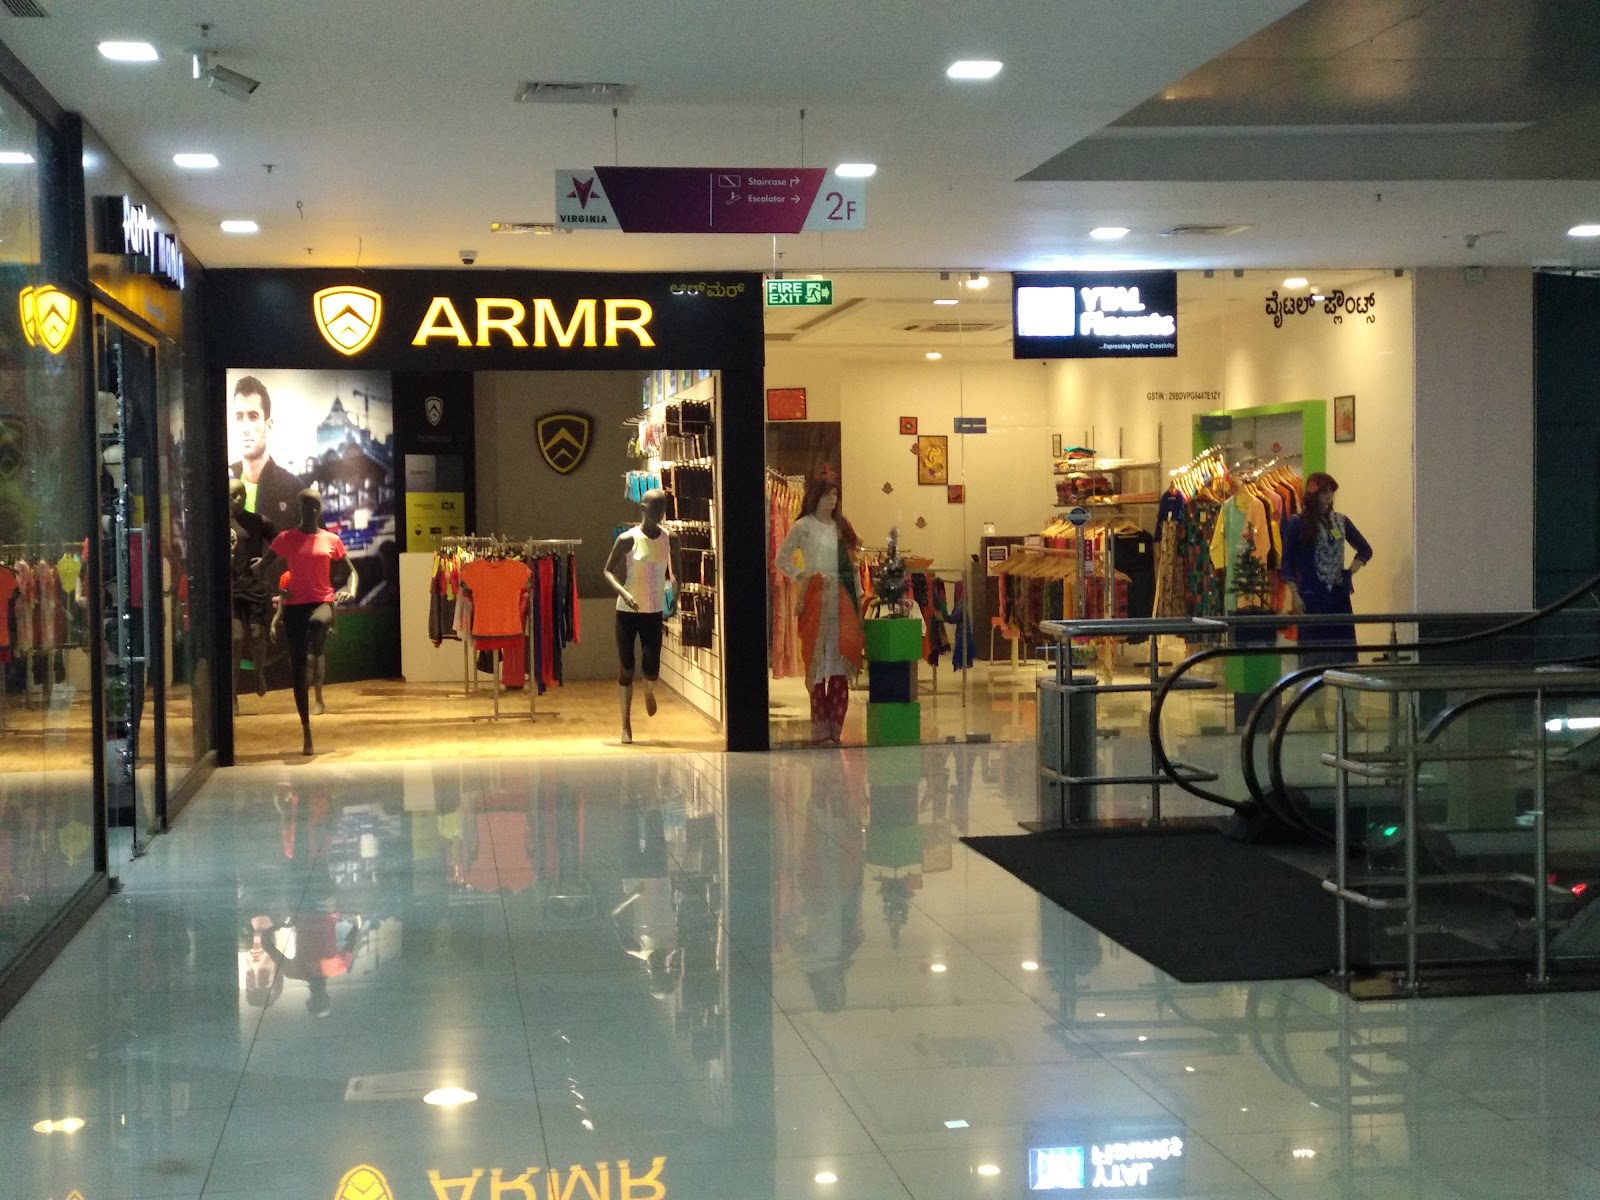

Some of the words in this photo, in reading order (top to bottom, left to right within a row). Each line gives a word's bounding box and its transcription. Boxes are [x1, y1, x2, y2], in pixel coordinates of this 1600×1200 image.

[748, 177, 787, 186] Staircase
[748, 194, 786, 203] Escalator
[826, 191, 856, 220] 2F
[560, 214, 607, 223] VIRGINIA
[769, 282, 802, 293] FIRE
[769, 293, 801, 304] EXIT
[411, 296, 656, 347] ARMR
[1132, 342, 1149, 350] Native
[1150, 342, 1175, 350] Creativity
